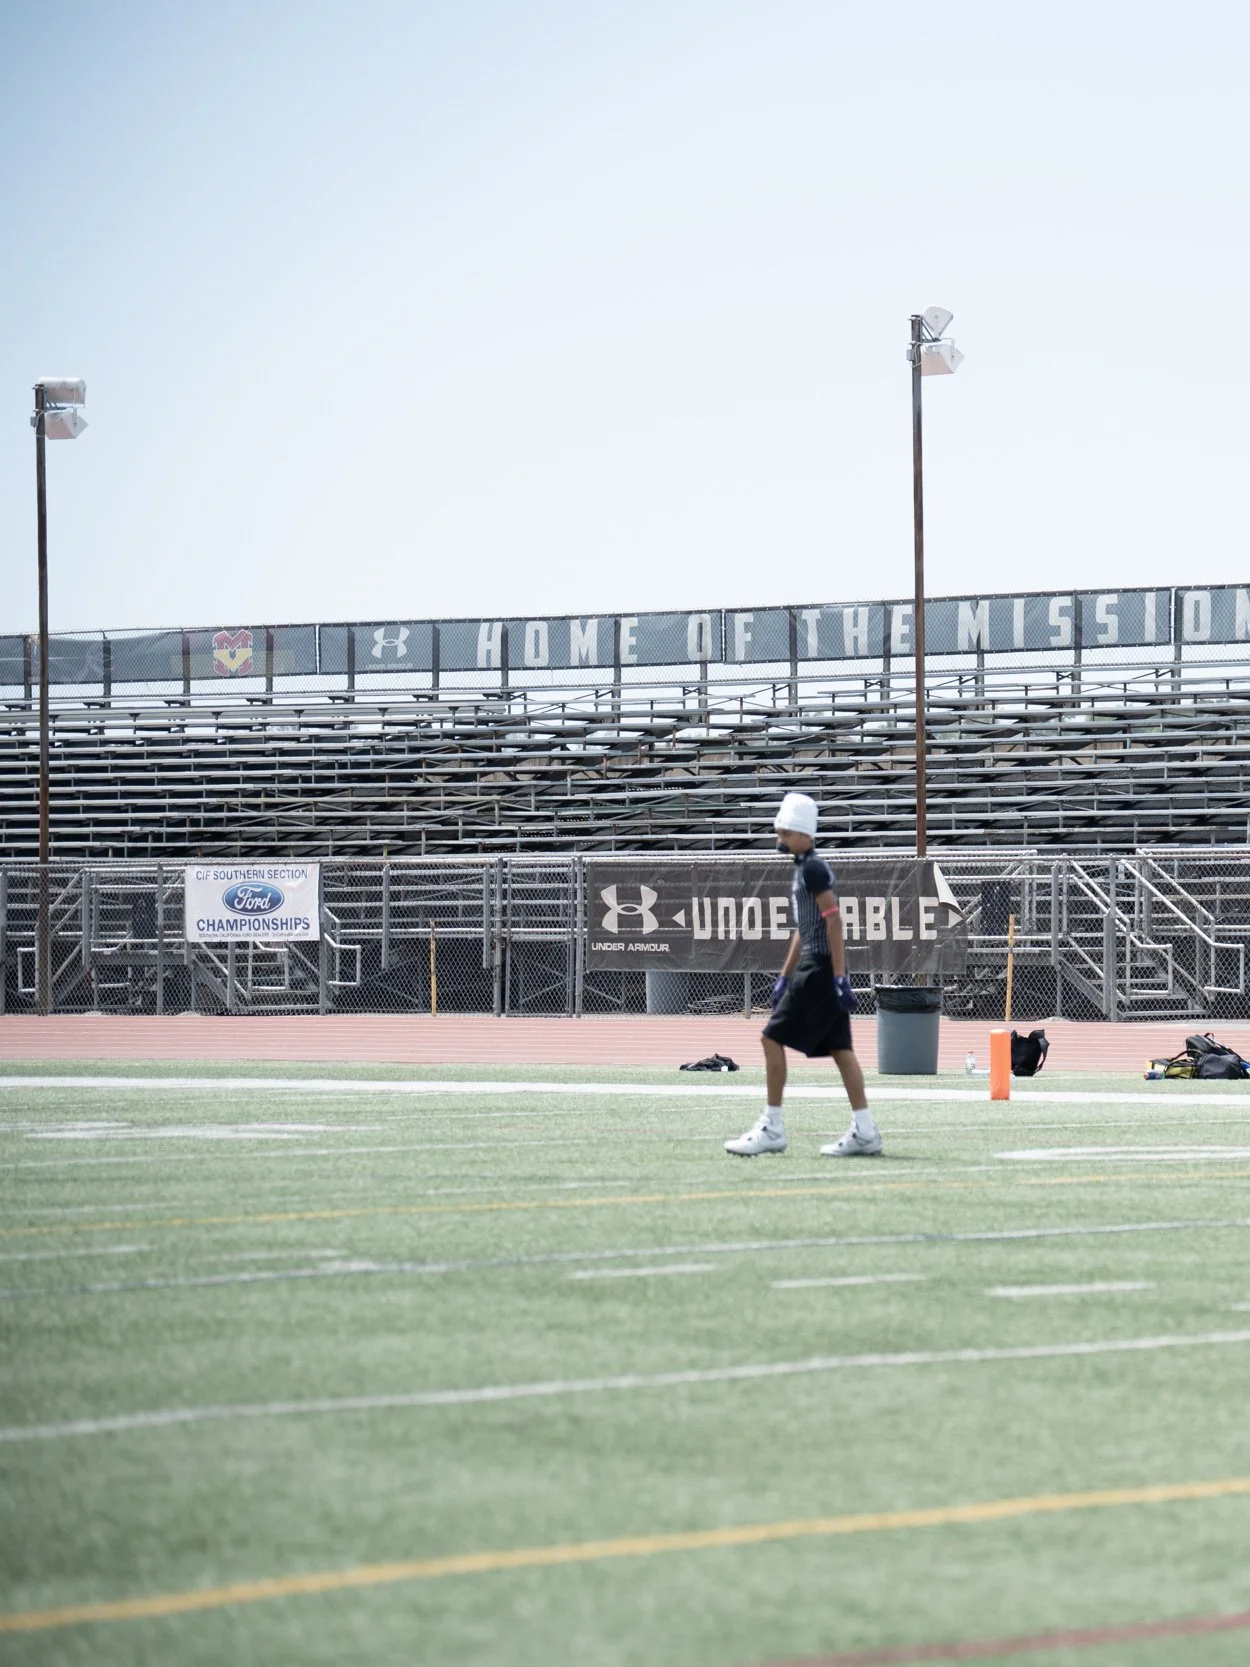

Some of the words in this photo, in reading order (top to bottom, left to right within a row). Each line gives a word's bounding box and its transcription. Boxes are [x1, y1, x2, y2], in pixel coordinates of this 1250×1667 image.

[477, 617, 639, 668] HOME
[687, 612, 755, 662] OF
[801, 605, 915, 658] THE
[196, 870, 211, 880] CIF
[213, 869, 265, 880] SOUTHERN
[267, 869, 308, 879] SECTION
[234, 886, 272, 910] Ford
[197, 917, 311, 932] CHAMPIONSHIPS
[692, 896, 939, 941] UNDEABLE
[591, 942, 625, 951] UNDER
[627, 943, 670, 952] ARMOUR
